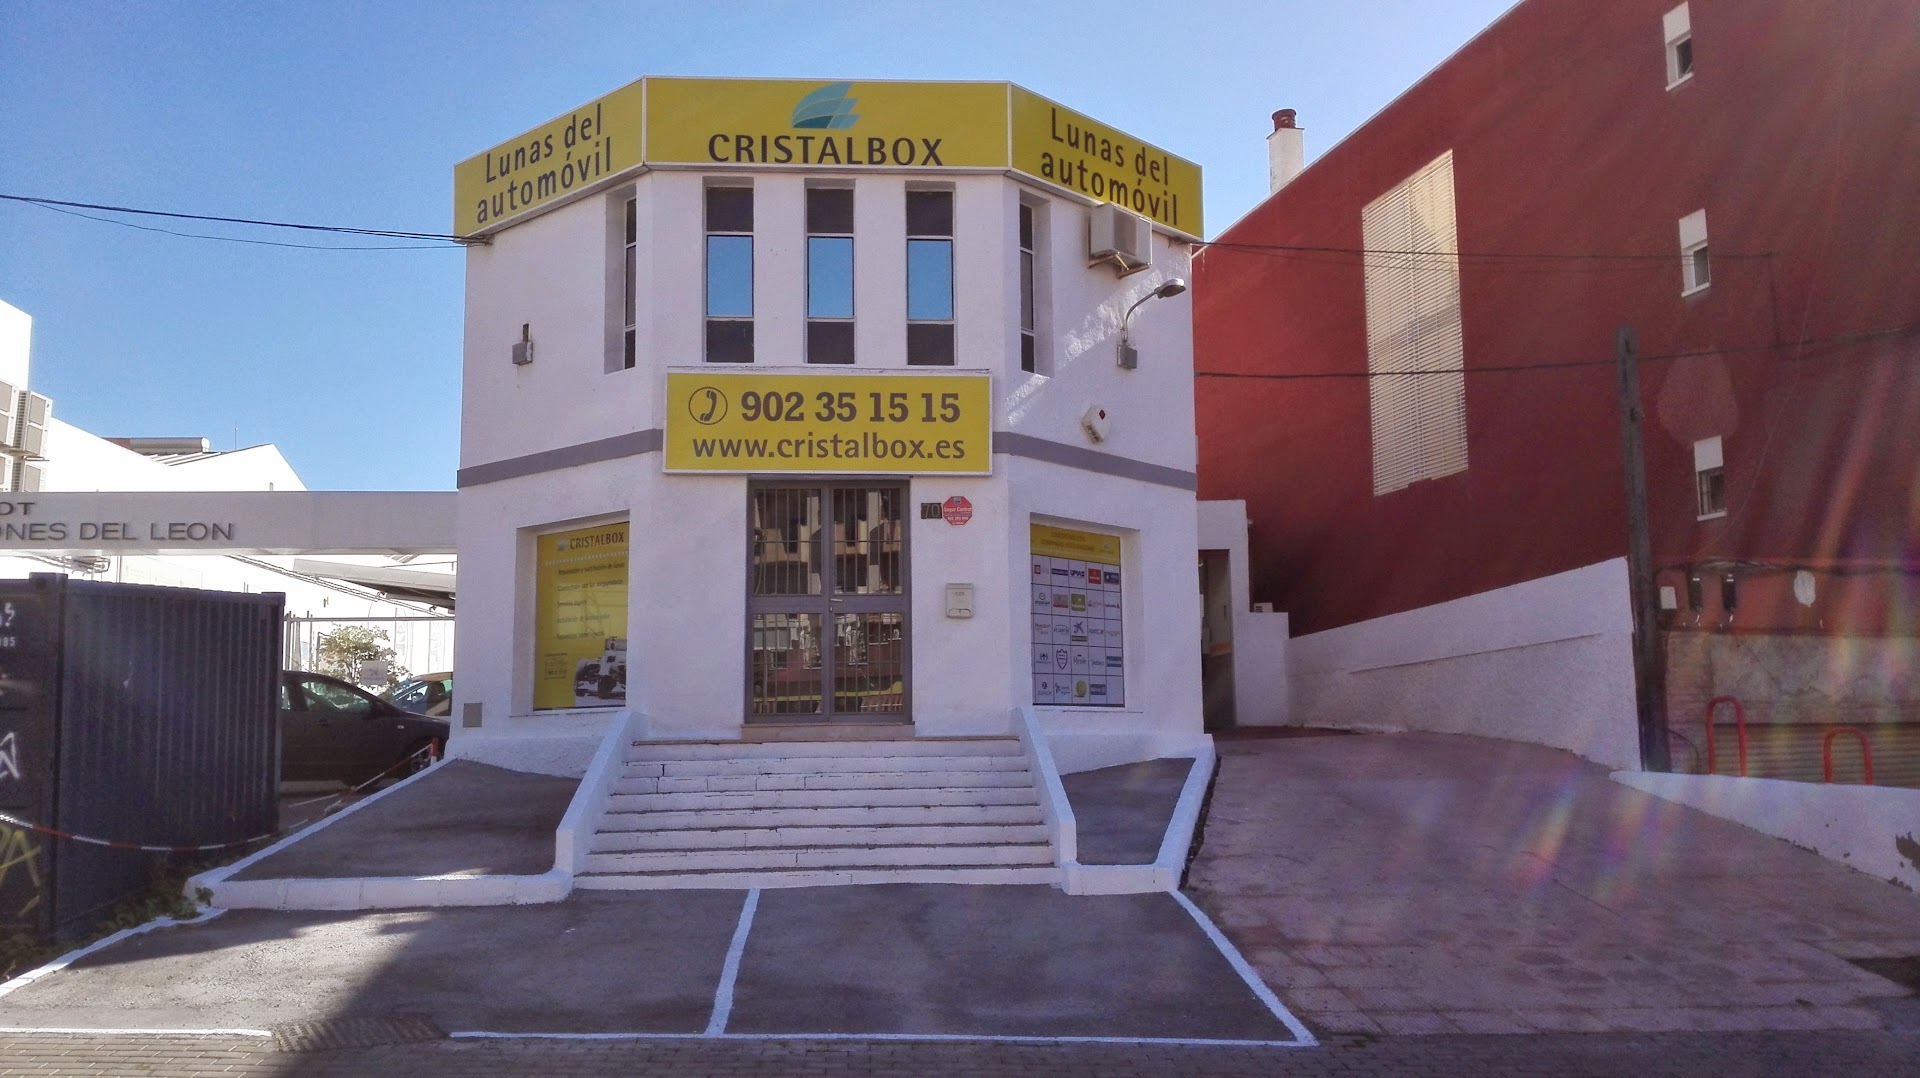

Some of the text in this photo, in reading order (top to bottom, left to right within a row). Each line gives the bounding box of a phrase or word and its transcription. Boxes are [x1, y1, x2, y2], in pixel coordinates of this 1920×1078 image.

[486, 103, 601, 183] Lunas del
[707, 133, 943, 166] CRISTALBOX
[1051, 107, 1168, 186] Lunas del
[477, 137, 611, 224] automóvil
[1041, 152, 1177, 226] automóvil
[741, 391, 960, 422] 902 35 15 15
[692, 432, 965, 459] www.cristalbox.es
[921, 504, 940, 518] 70
[0, 522, 235, 541] NES DEL LEON
[570, 531, 625, 549] CRISTALBOX
